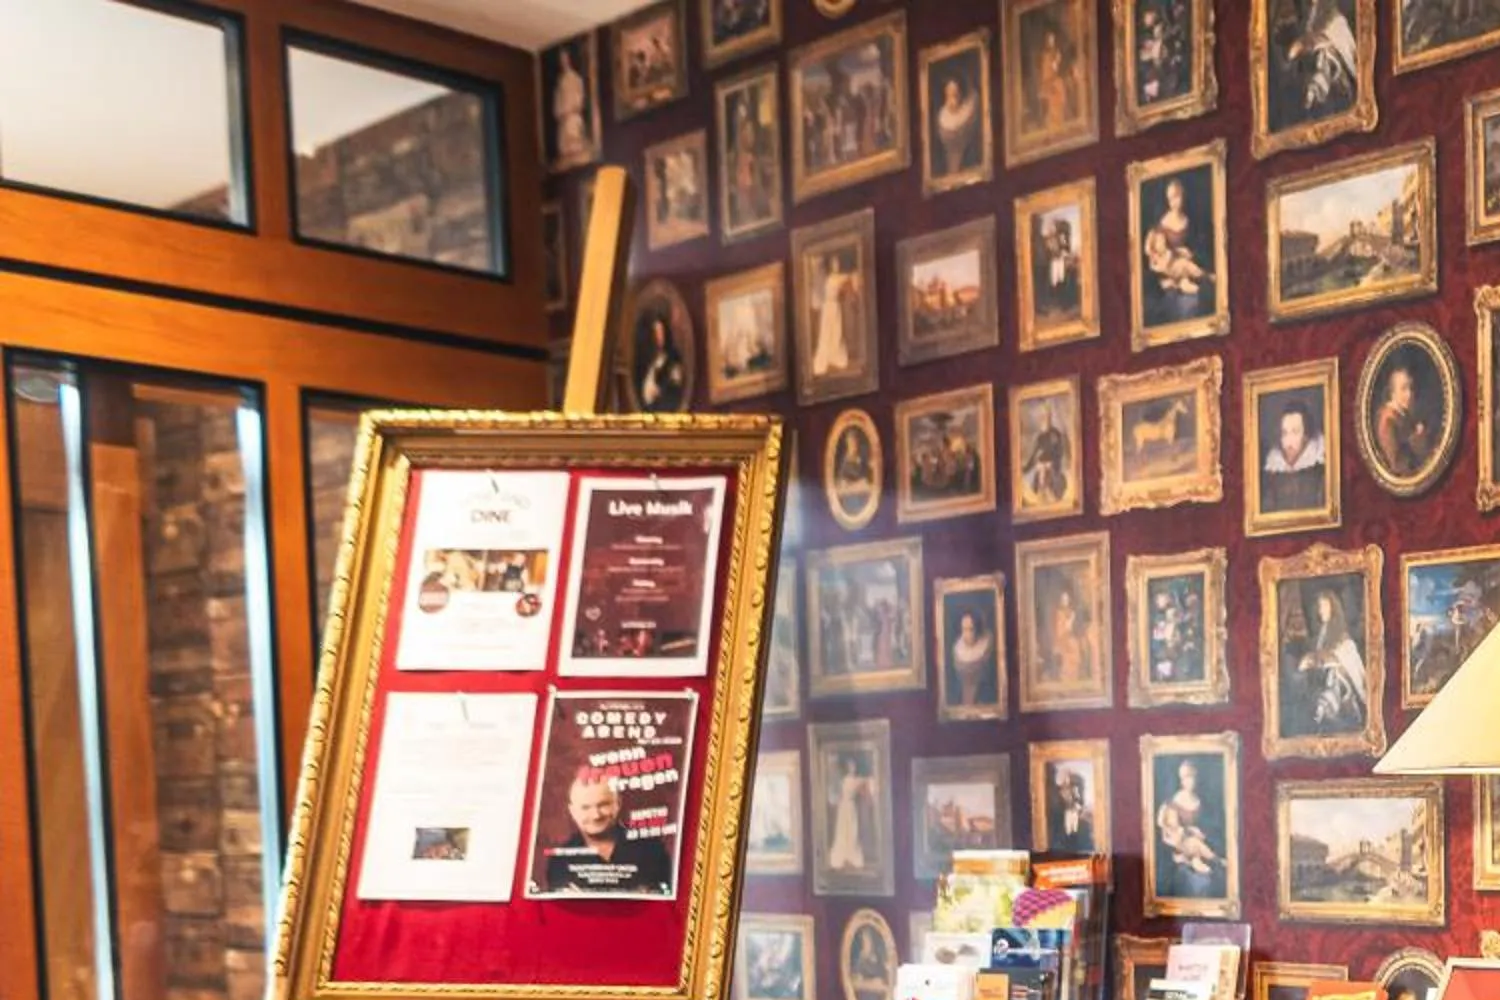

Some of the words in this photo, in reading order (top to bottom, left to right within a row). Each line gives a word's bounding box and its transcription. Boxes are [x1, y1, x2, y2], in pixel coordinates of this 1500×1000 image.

[608, 500, 642, 516] Live
[646, 500, 693, 516] Musik
[575, 711, 667, 725] COMEDY
[589, 747, 646, 767] wenn
[578, 751, 673, 785] frauen
[607, 769, 679, 792] fragen
